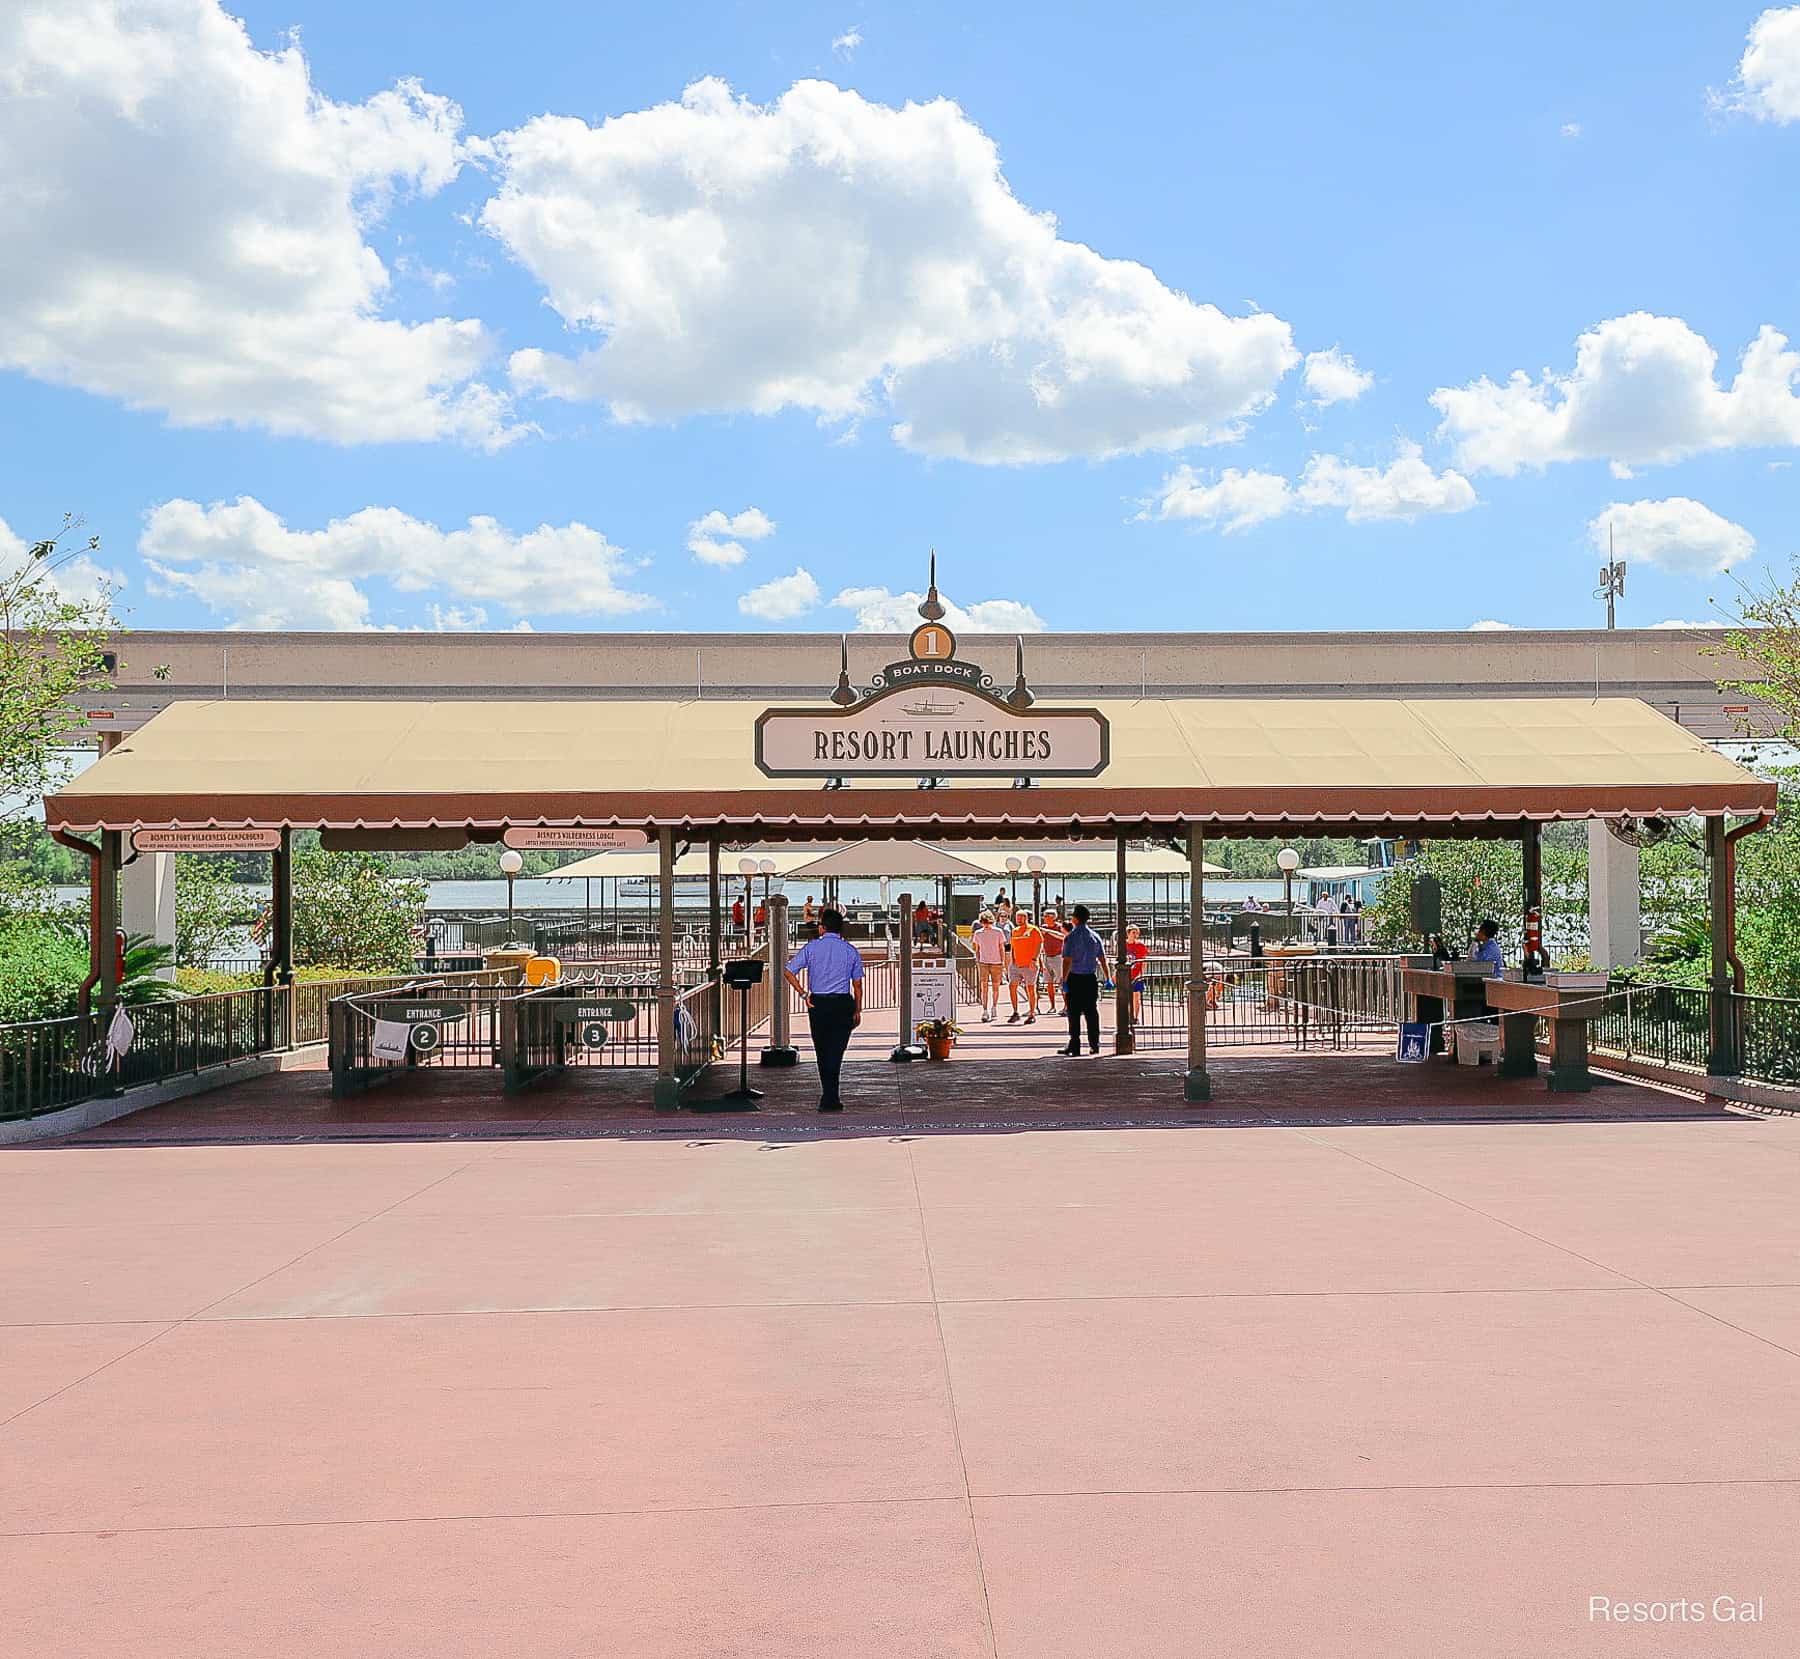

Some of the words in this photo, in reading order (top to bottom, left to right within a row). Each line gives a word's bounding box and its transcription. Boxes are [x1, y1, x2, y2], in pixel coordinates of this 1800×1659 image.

[925, 631, 940, 655] 1
[893, 665, 929, 677] BOAT
[934, 665, 972, 677] DOCK
[813, 730, 913, 760] RESORT
[924, 730, 1051, 760] LAUNCHES
[406, 1008, 442, 1018] ENTRANCE
[578, 1007, 613, 1017] ENTRANCE
[420, 1031, 430, 1043] 2
[591, 1030, 600, 1042] 3
